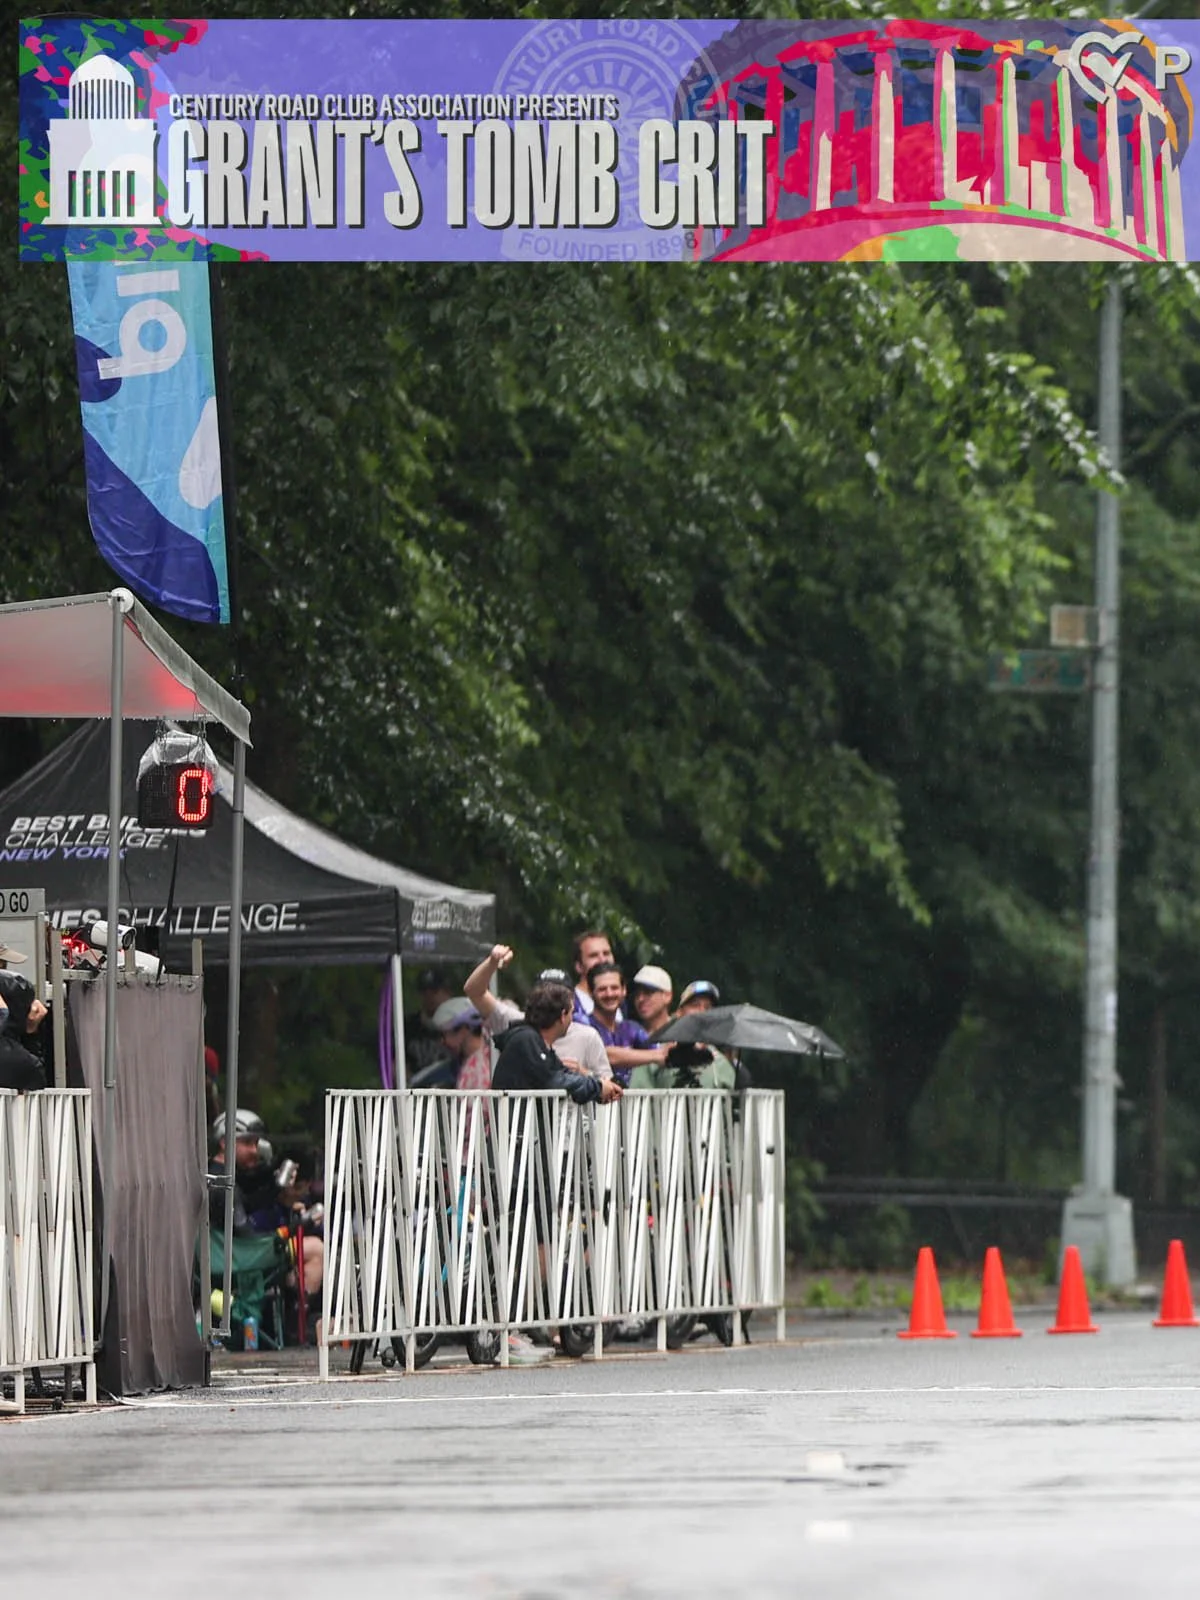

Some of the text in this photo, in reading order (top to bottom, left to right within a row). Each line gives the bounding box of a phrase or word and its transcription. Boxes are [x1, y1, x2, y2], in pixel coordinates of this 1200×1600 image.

[178, 769, 208, 822] 0
[10, 815, 85, 833] BEST
[0, 847, 56, 862] NEW
[9, 891, 29, 913] GO
